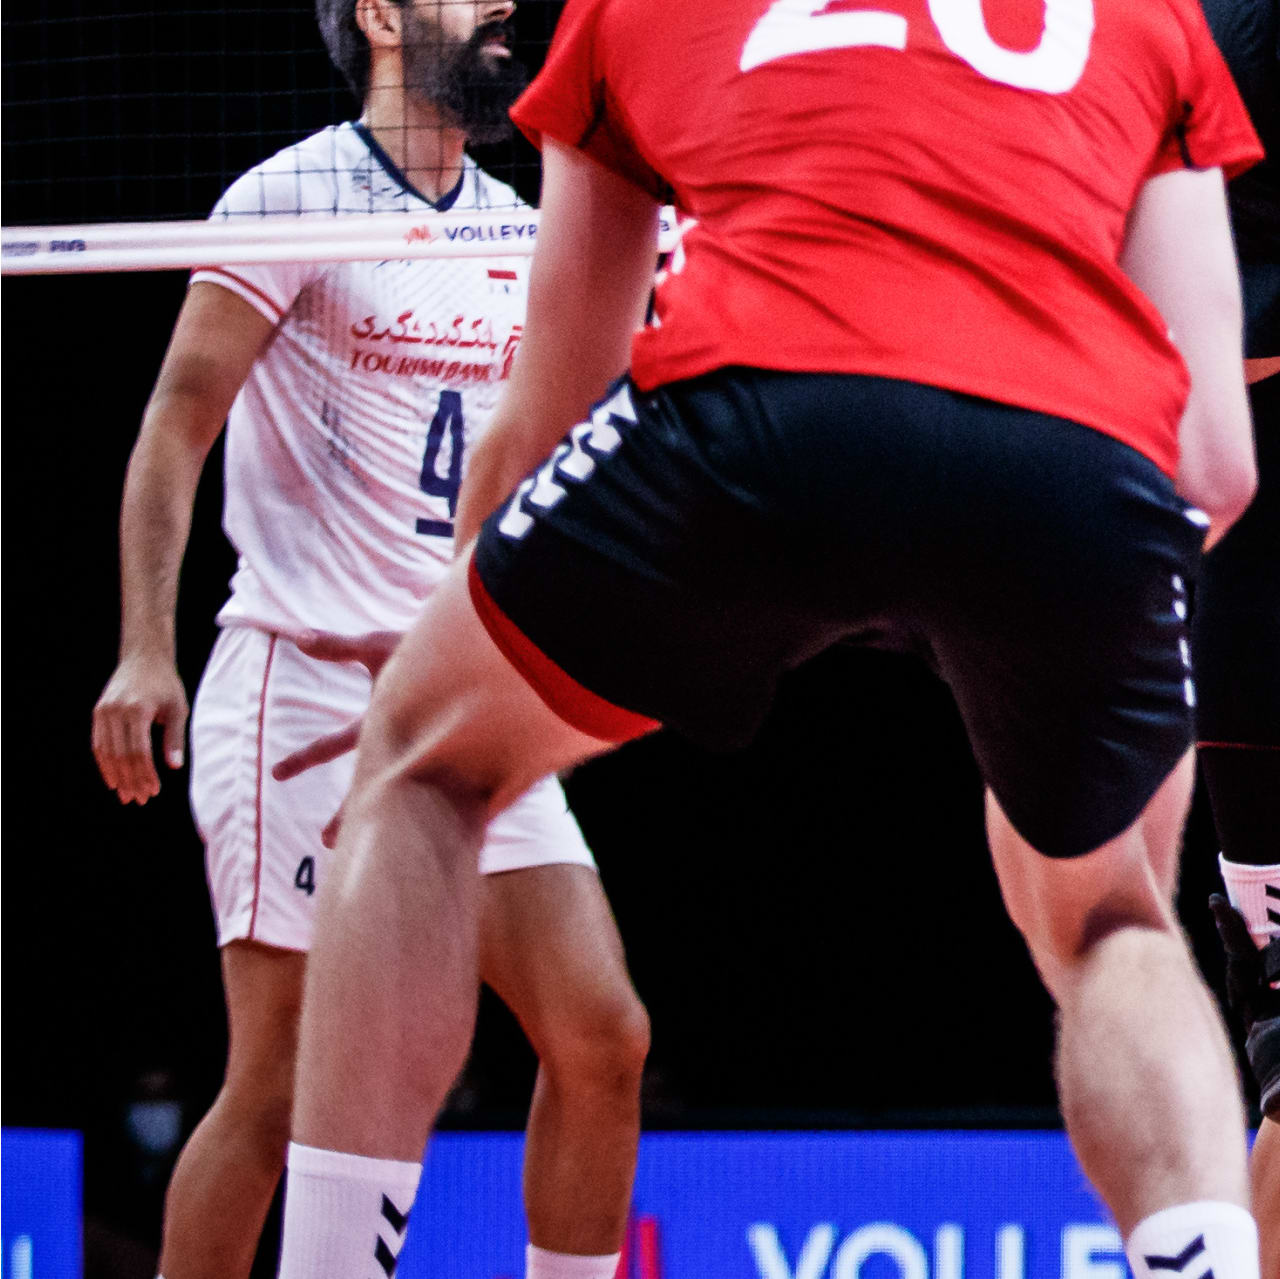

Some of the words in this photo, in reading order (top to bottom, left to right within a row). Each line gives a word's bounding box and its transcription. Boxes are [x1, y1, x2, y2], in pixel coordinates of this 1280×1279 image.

[444, 223, 537, 243] VOLLEYB
[416, 389, 465, 538] 4
[294, 854, 316, 897] 4
